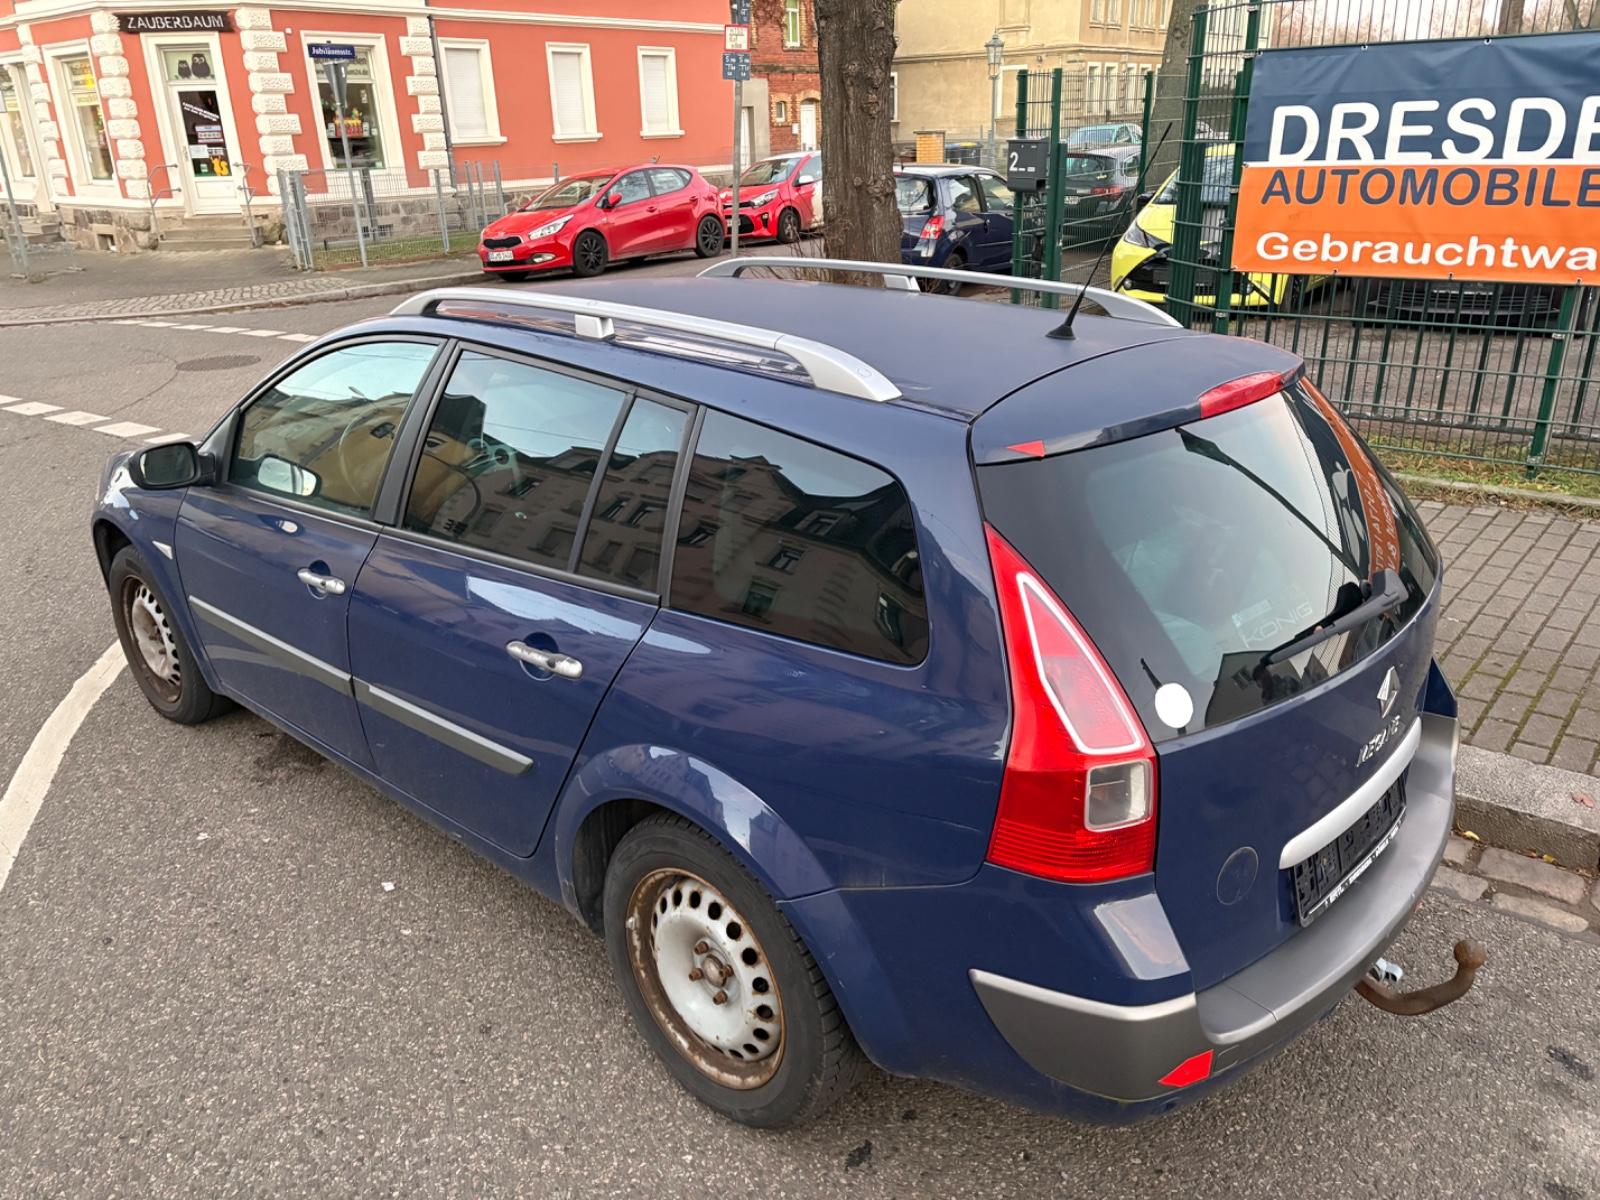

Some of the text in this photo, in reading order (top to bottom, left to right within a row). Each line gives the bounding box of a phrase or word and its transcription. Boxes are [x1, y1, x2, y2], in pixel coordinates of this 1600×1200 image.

[127, 15, 224, 29] ZAUBERBAUM
[1009, 151, 1018, 172] 2
[1261, 167, 1600, 207] AUTOMOBILE
[1256, 232, 1598, 271] Gebrauchtwa
